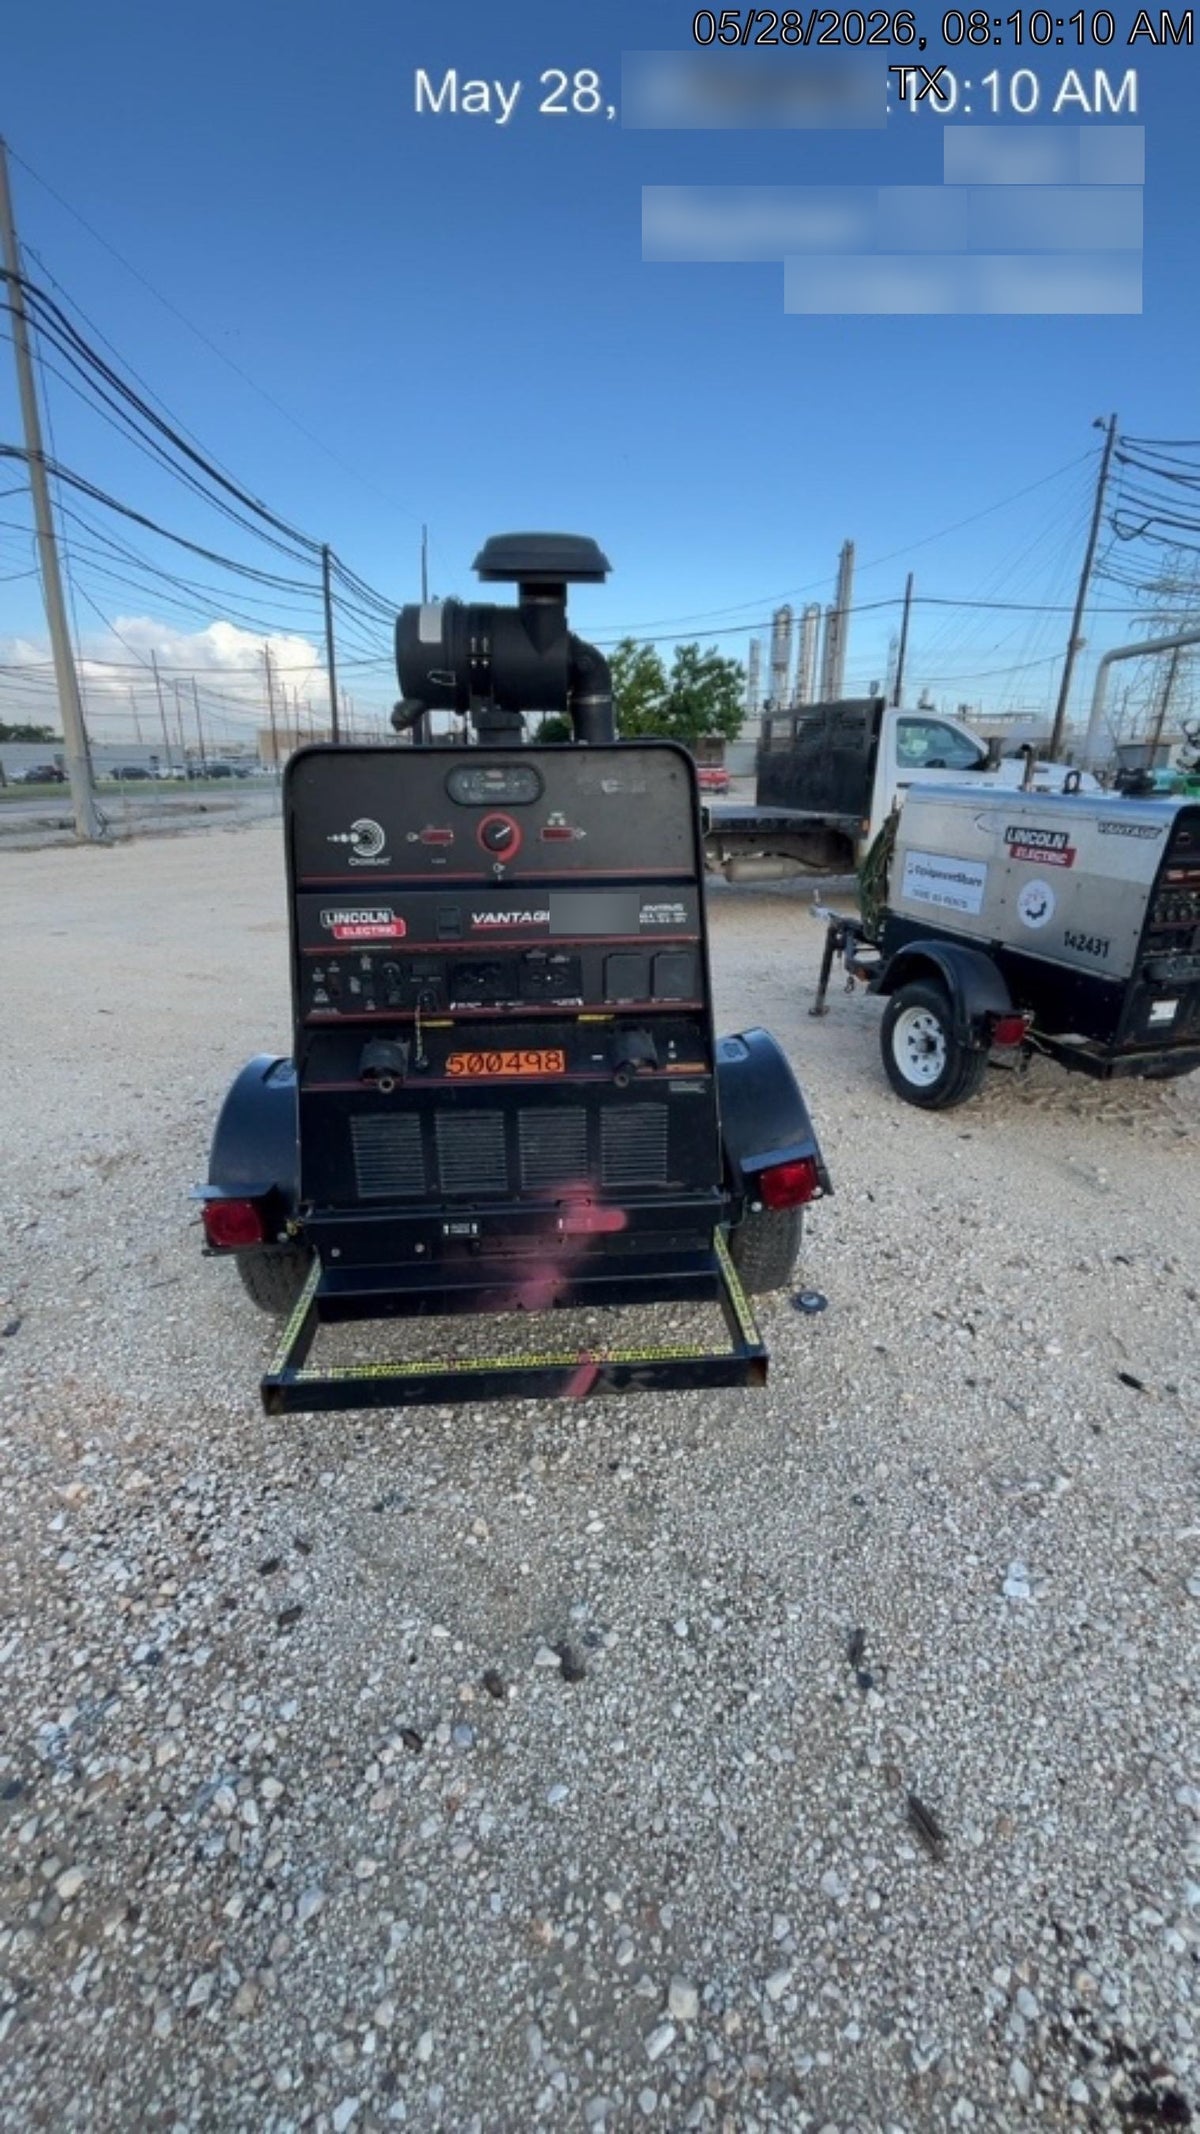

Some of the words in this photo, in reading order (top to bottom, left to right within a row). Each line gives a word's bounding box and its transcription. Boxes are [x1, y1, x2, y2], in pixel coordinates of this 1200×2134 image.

[1007, 827, 1066, 849] LINCOLN
[1014, 847, 1068, 865] ELECTRIC
[325, 911, 390, 925] LINCOLN
[1064, 930, 1109, 958] 142431
[448, 1051, 562, 1075] 500498
